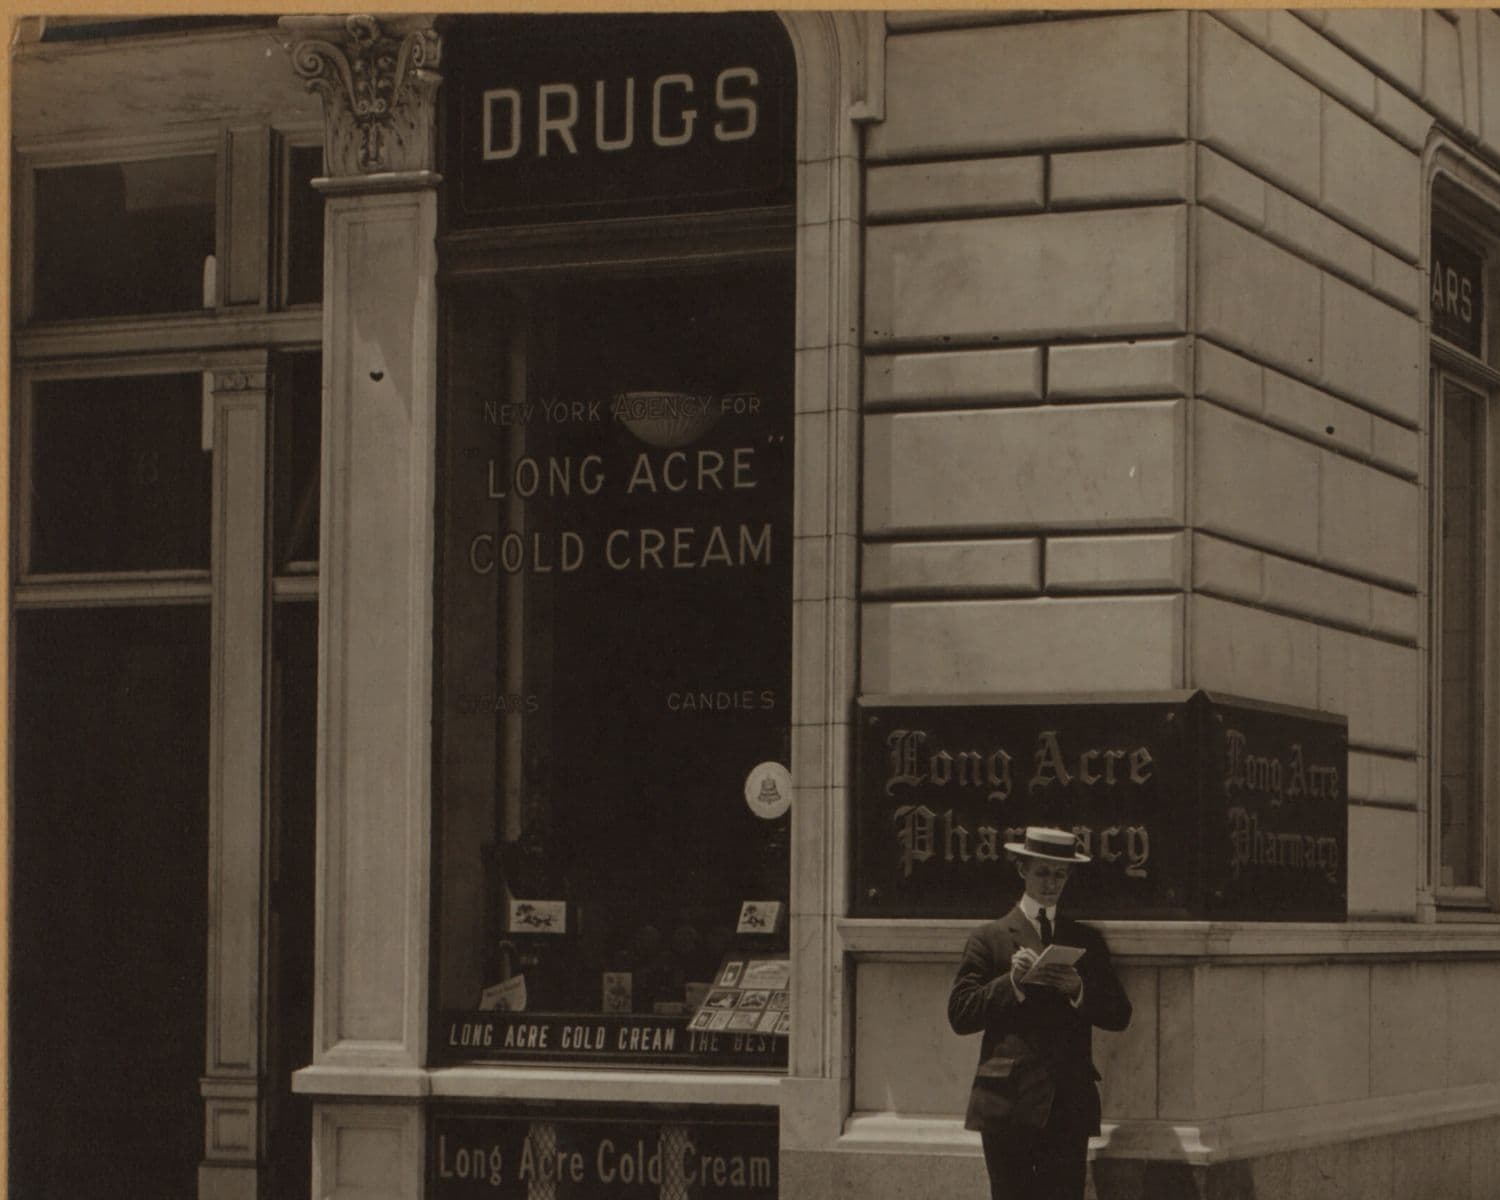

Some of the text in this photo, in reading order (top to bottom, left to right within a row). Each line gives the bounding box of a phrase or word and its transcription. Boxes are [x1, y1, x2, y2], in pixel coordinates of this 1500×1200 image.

[482, 66, 760, 161] DRUGS
[541, 398, 601, 424] YORK
[720, 396, 761, 416] FOR
[470, 523, 773, 576] COLD CREAM
[667, 690, 776, 711] CANDIES
[886, 728, 1155, 801] Long Acre
[1223, 728, 1339, 808] Long Acre
[893, 804, 1151, 880] Pharacy
[449, 1023, 494, 1046] LONG
[618, 1027, 675, 1051] CREAM
[439, 1134, 771, 1187] Long Acre Cold Cream
